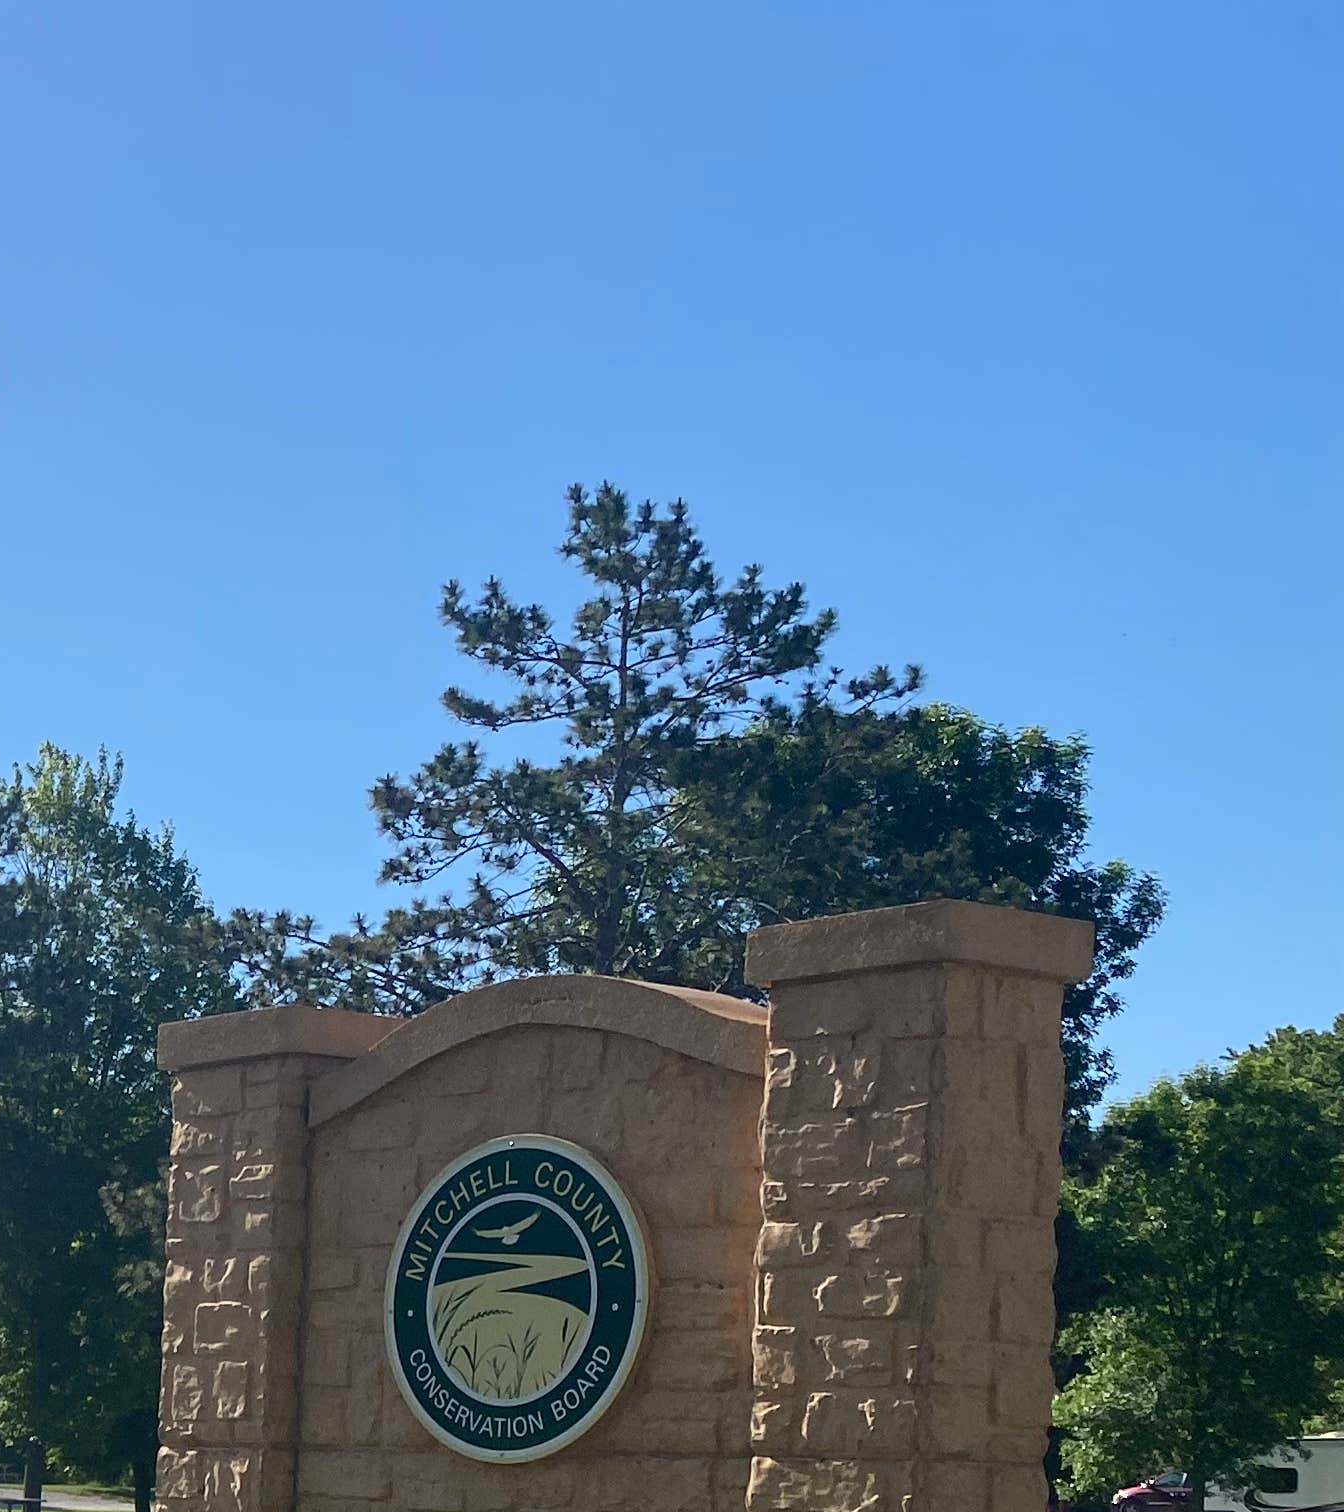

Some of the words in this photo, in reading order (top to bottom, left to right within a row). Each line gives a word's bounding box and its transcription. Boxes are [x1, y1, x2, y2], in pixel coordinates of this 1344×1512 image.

[405, 1160, 518, 1281] MITCHELL
[534, 1162, 626, 1269] COUNTY
[409, 1349, 544, 1438] CONSERVATION
[551, 1345, 611, 1422] BOARD
